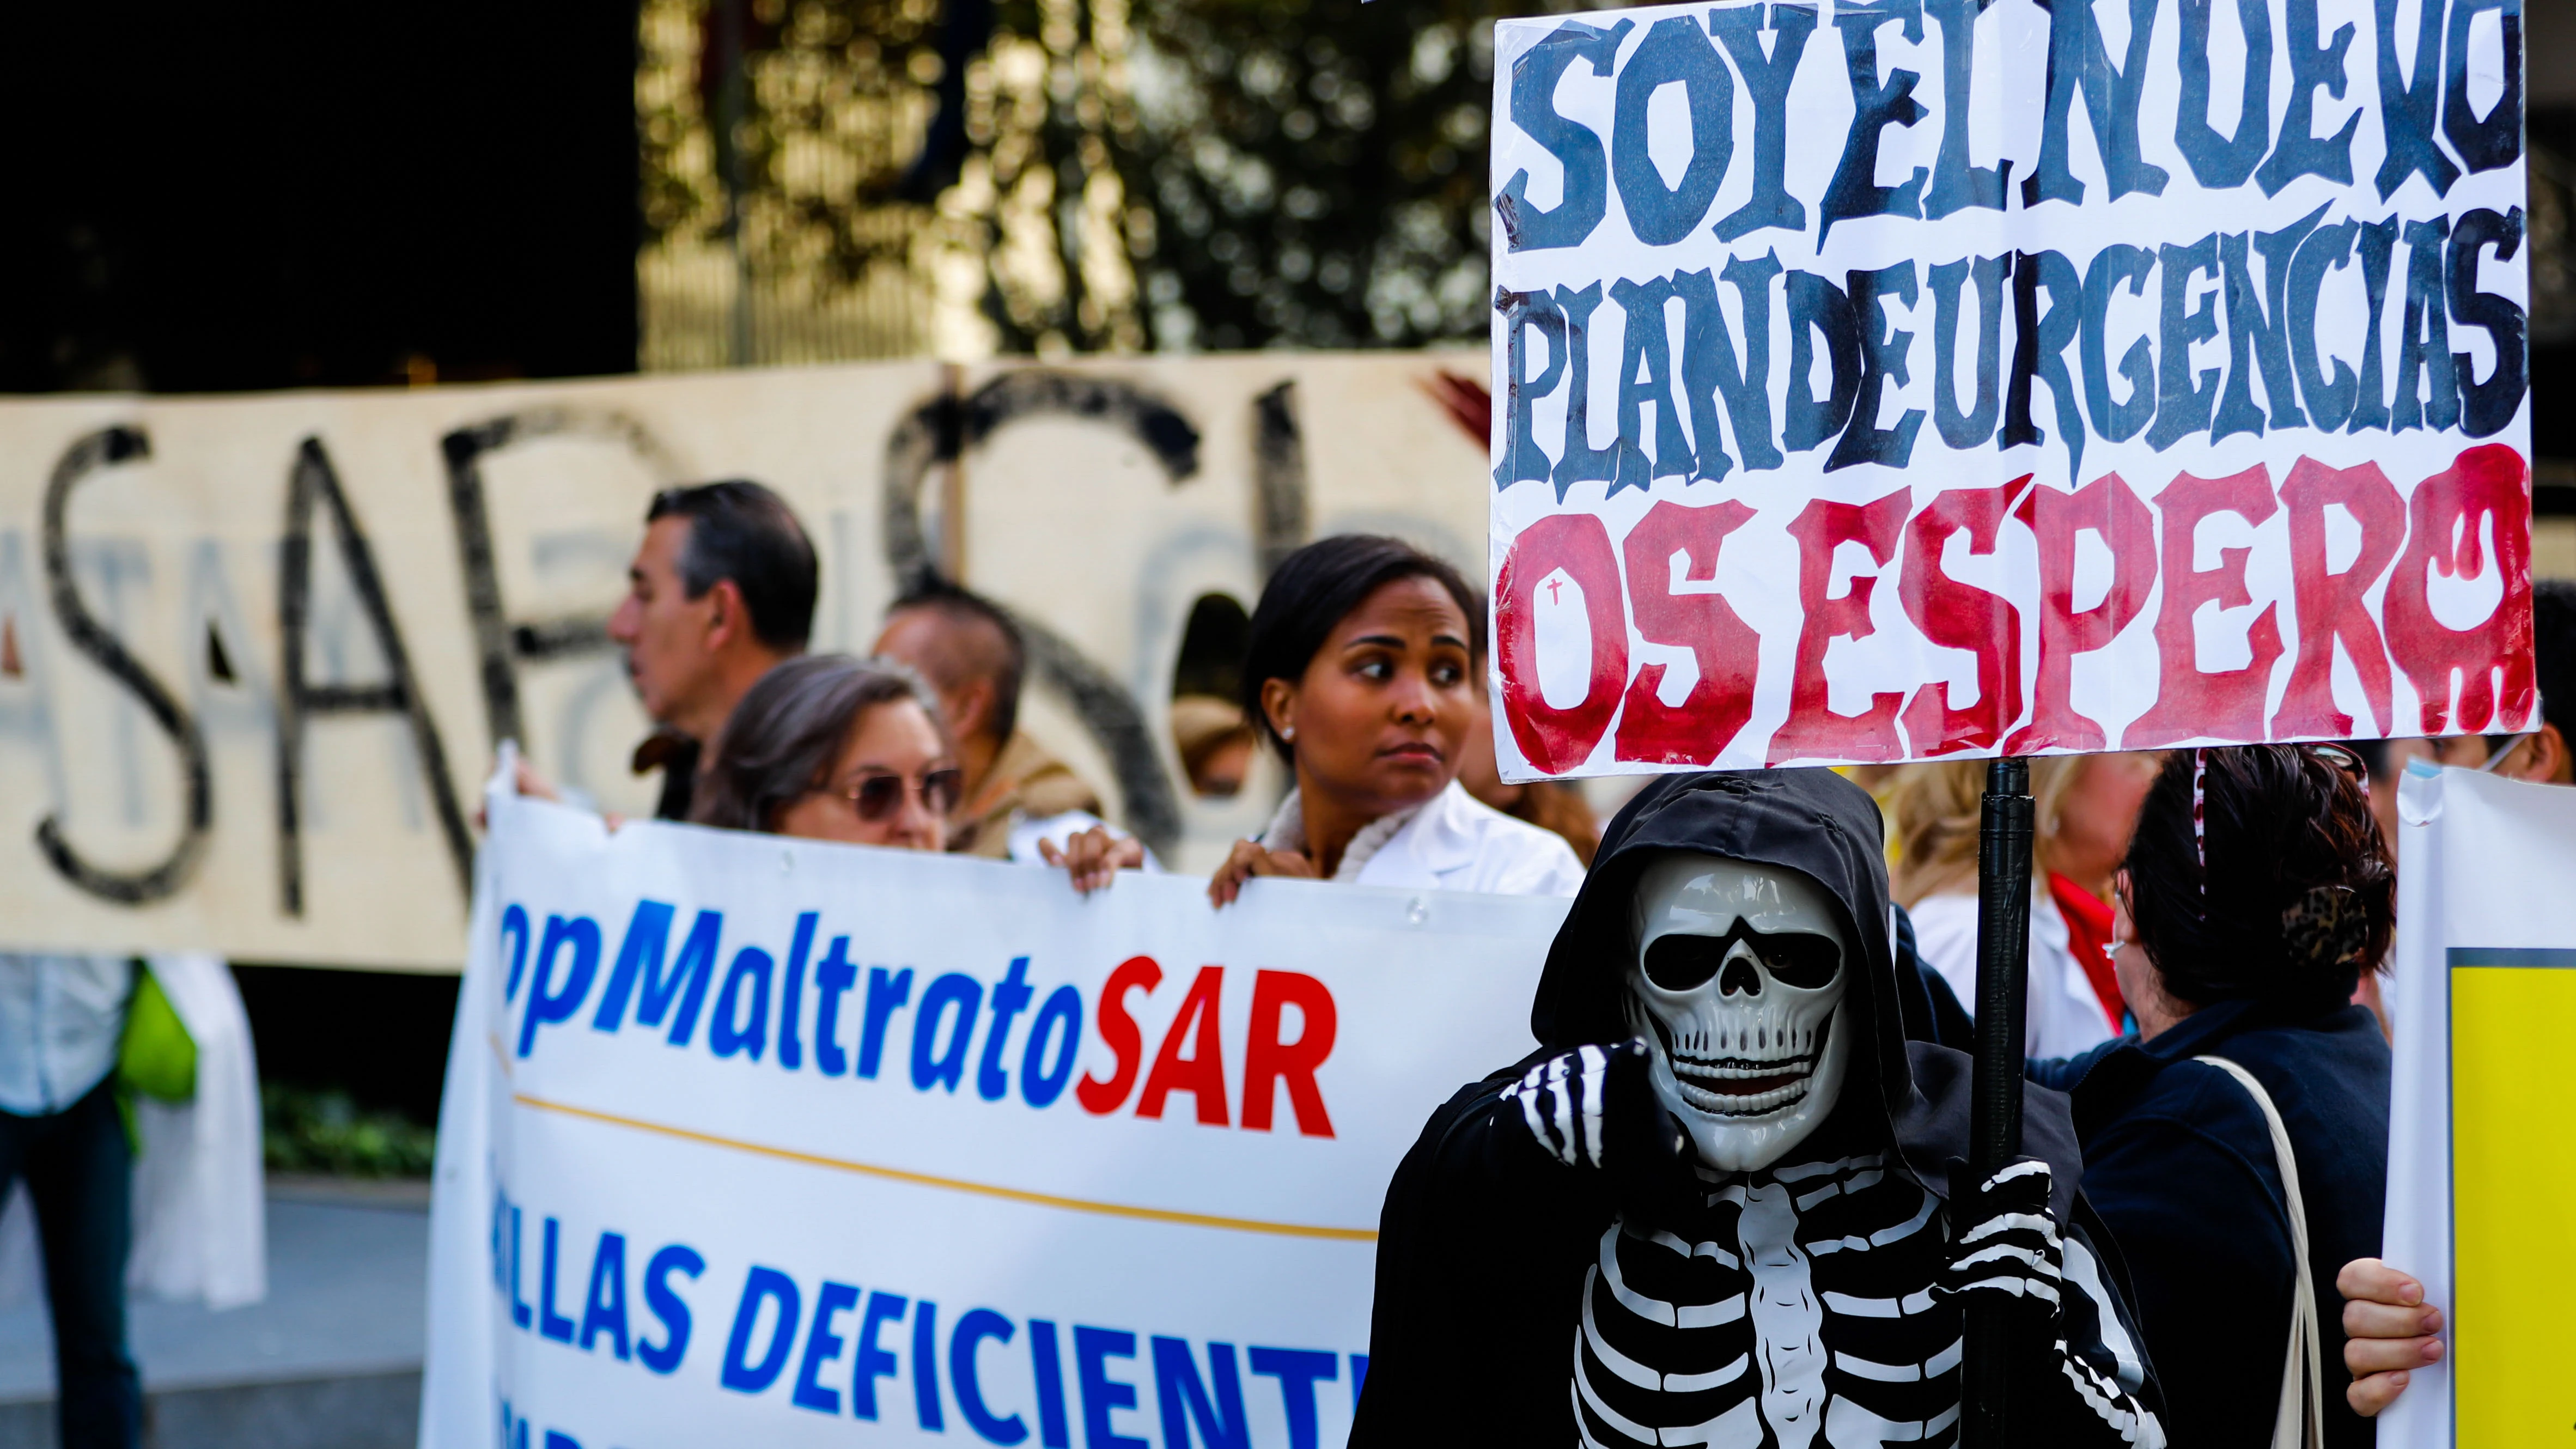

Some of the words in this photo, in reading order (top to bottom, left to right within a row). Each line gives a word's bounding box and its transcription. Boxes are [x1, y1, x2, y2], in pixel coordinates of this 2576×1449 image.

[1491, 3, 1818, 254] SOY
[1817, 0, 2013, 256] EL
[2020, 0, 2522, 205] NUEVO
[1493, 245, 1785, 506] PLAN
[1781, 258, 1927, 473] DE
[1926, 198, 2529, 488] URGENCIAS
[1495, 498, 1762, 775] OS
[1765, 442, 2534, 769] ESPERO
[720, 1264, 1369, 1449] DEFICIENT
